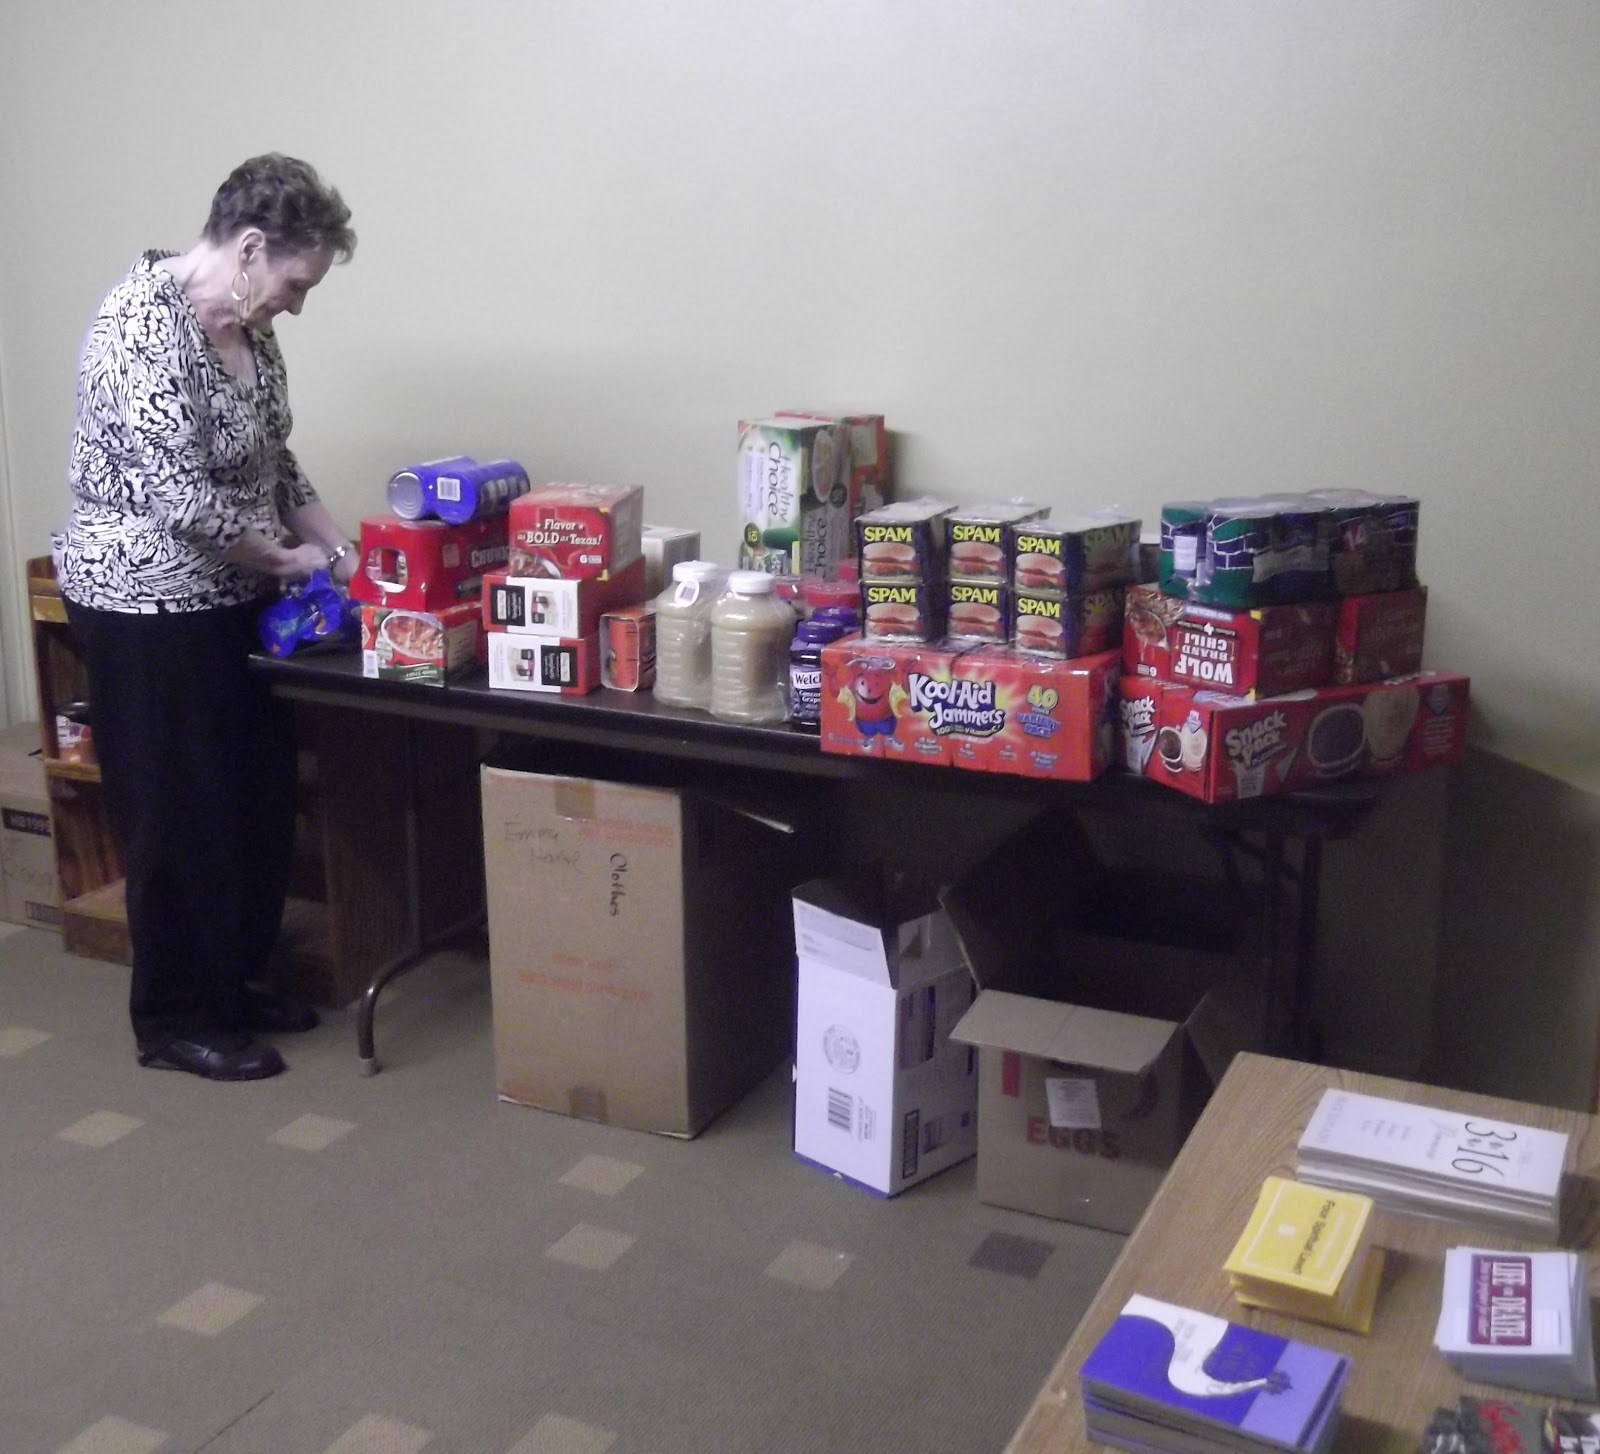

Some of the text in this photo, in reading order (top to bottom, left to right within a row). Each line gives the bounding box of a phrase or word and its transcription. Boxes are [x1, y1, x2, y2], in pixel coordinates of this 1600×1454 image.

[768, 441, 781, 516] Choice
[779, 456, 794, 523] Healthy
[544, 518, 576, 530] Flavor
[864, 526, 912, 542] SPAM
[953, 525, 1000, 542] SPAM
[526, 531, 560, 544] BOLD
[570, 533, 602, 545] Texas!
[1017, 535, 1060, 555] SPAM
[580, 555, 588, 564] 6
[868, 587, 916, 603] SPAM
[951, 586, 998, 603] SPAM
[1017, 598, 1060, 618] SPAM
[1182, 645, 1229, 661] BRAND
[1184, 633, 1227, 650] CHILI
[1175, 653, 1233, 685] WOLF
[908, 673, 993, 709] Kool-Aid
[1027, 684, 1058, 710] 40
[929, 702, 1004, 728] Jammers
[1120, 696, 1155, 719] Snack
[1225, 709, 1289, 755] Snack
[610, 852, 628, 917] Clothes
[1027, 1116, 1120, 1161] EGGS
[1450, 1121, 1518, 1177] 3:16
[1491, 1297, 1527, 1337] DEATH
